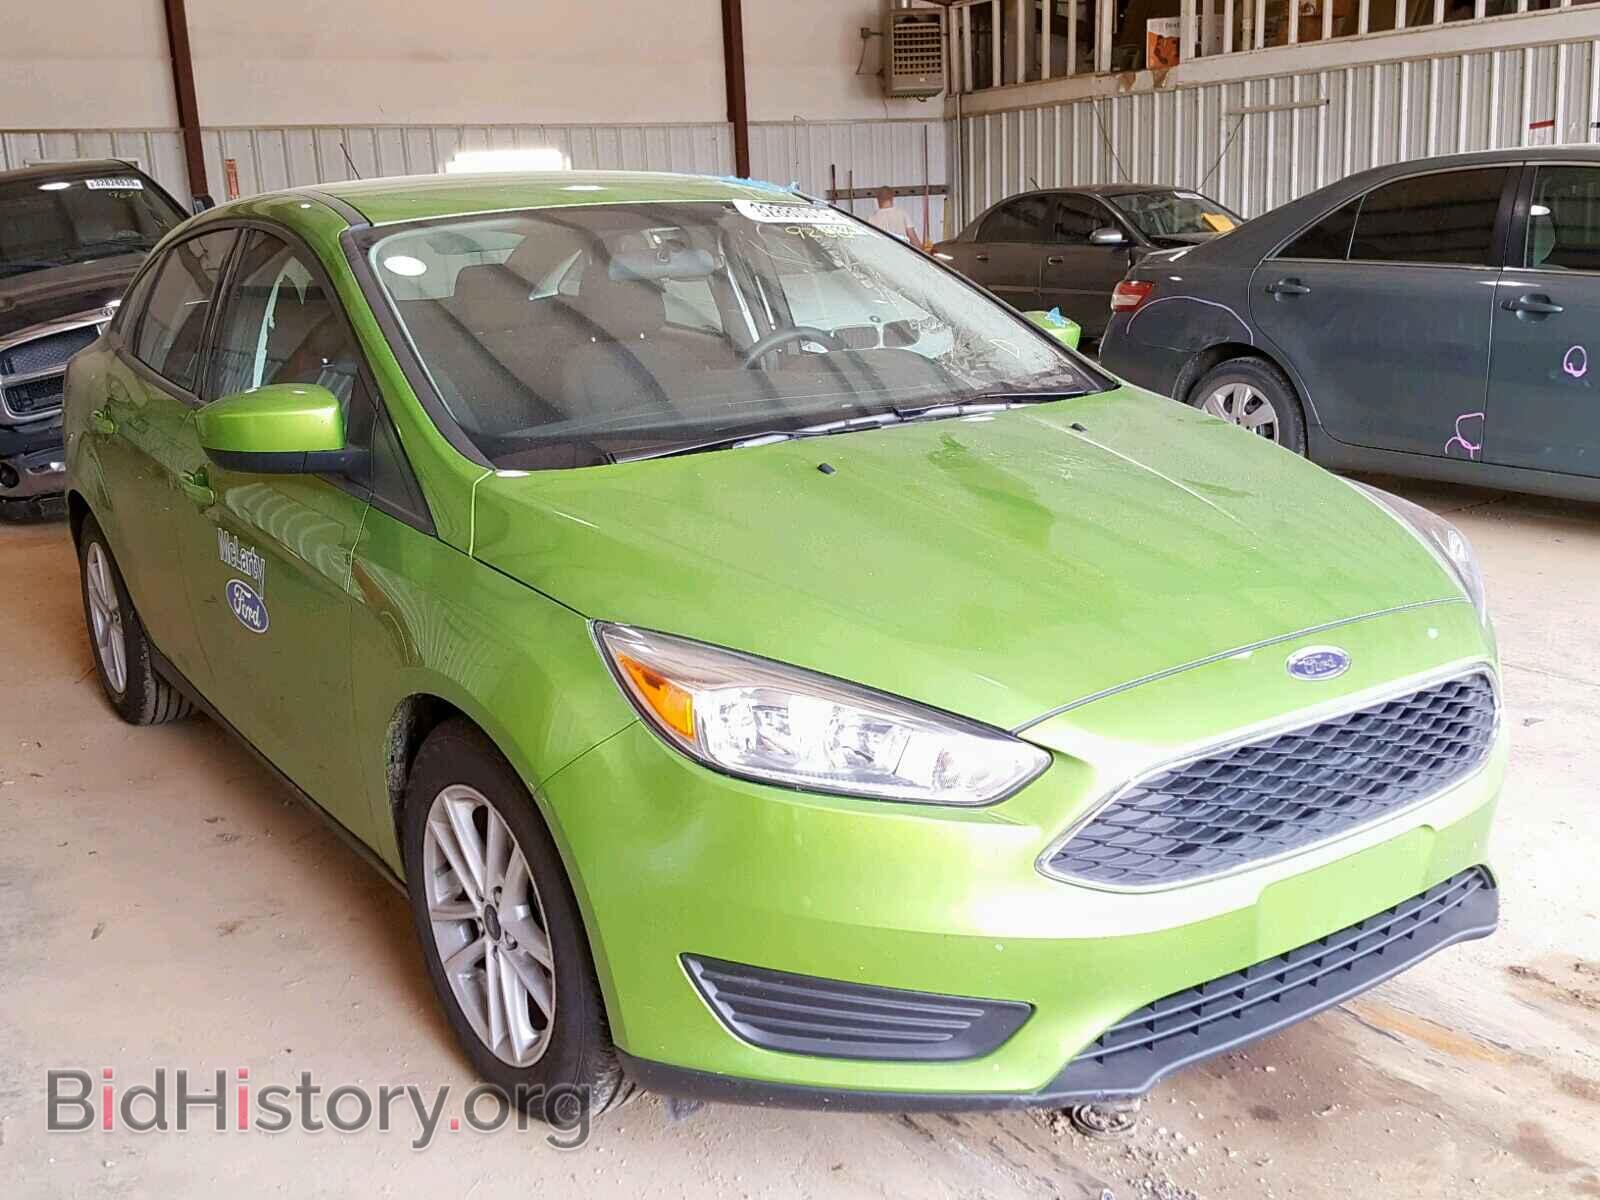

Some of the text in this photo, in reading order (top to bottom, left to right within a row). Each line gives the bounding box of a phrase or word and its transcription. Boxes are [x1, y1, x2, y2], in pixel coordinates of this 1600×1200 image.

[217, 527, 266, 600] McLarty
[233, 583, 262, 628] Ford
[1297, 654, 1338, 674] Ford
